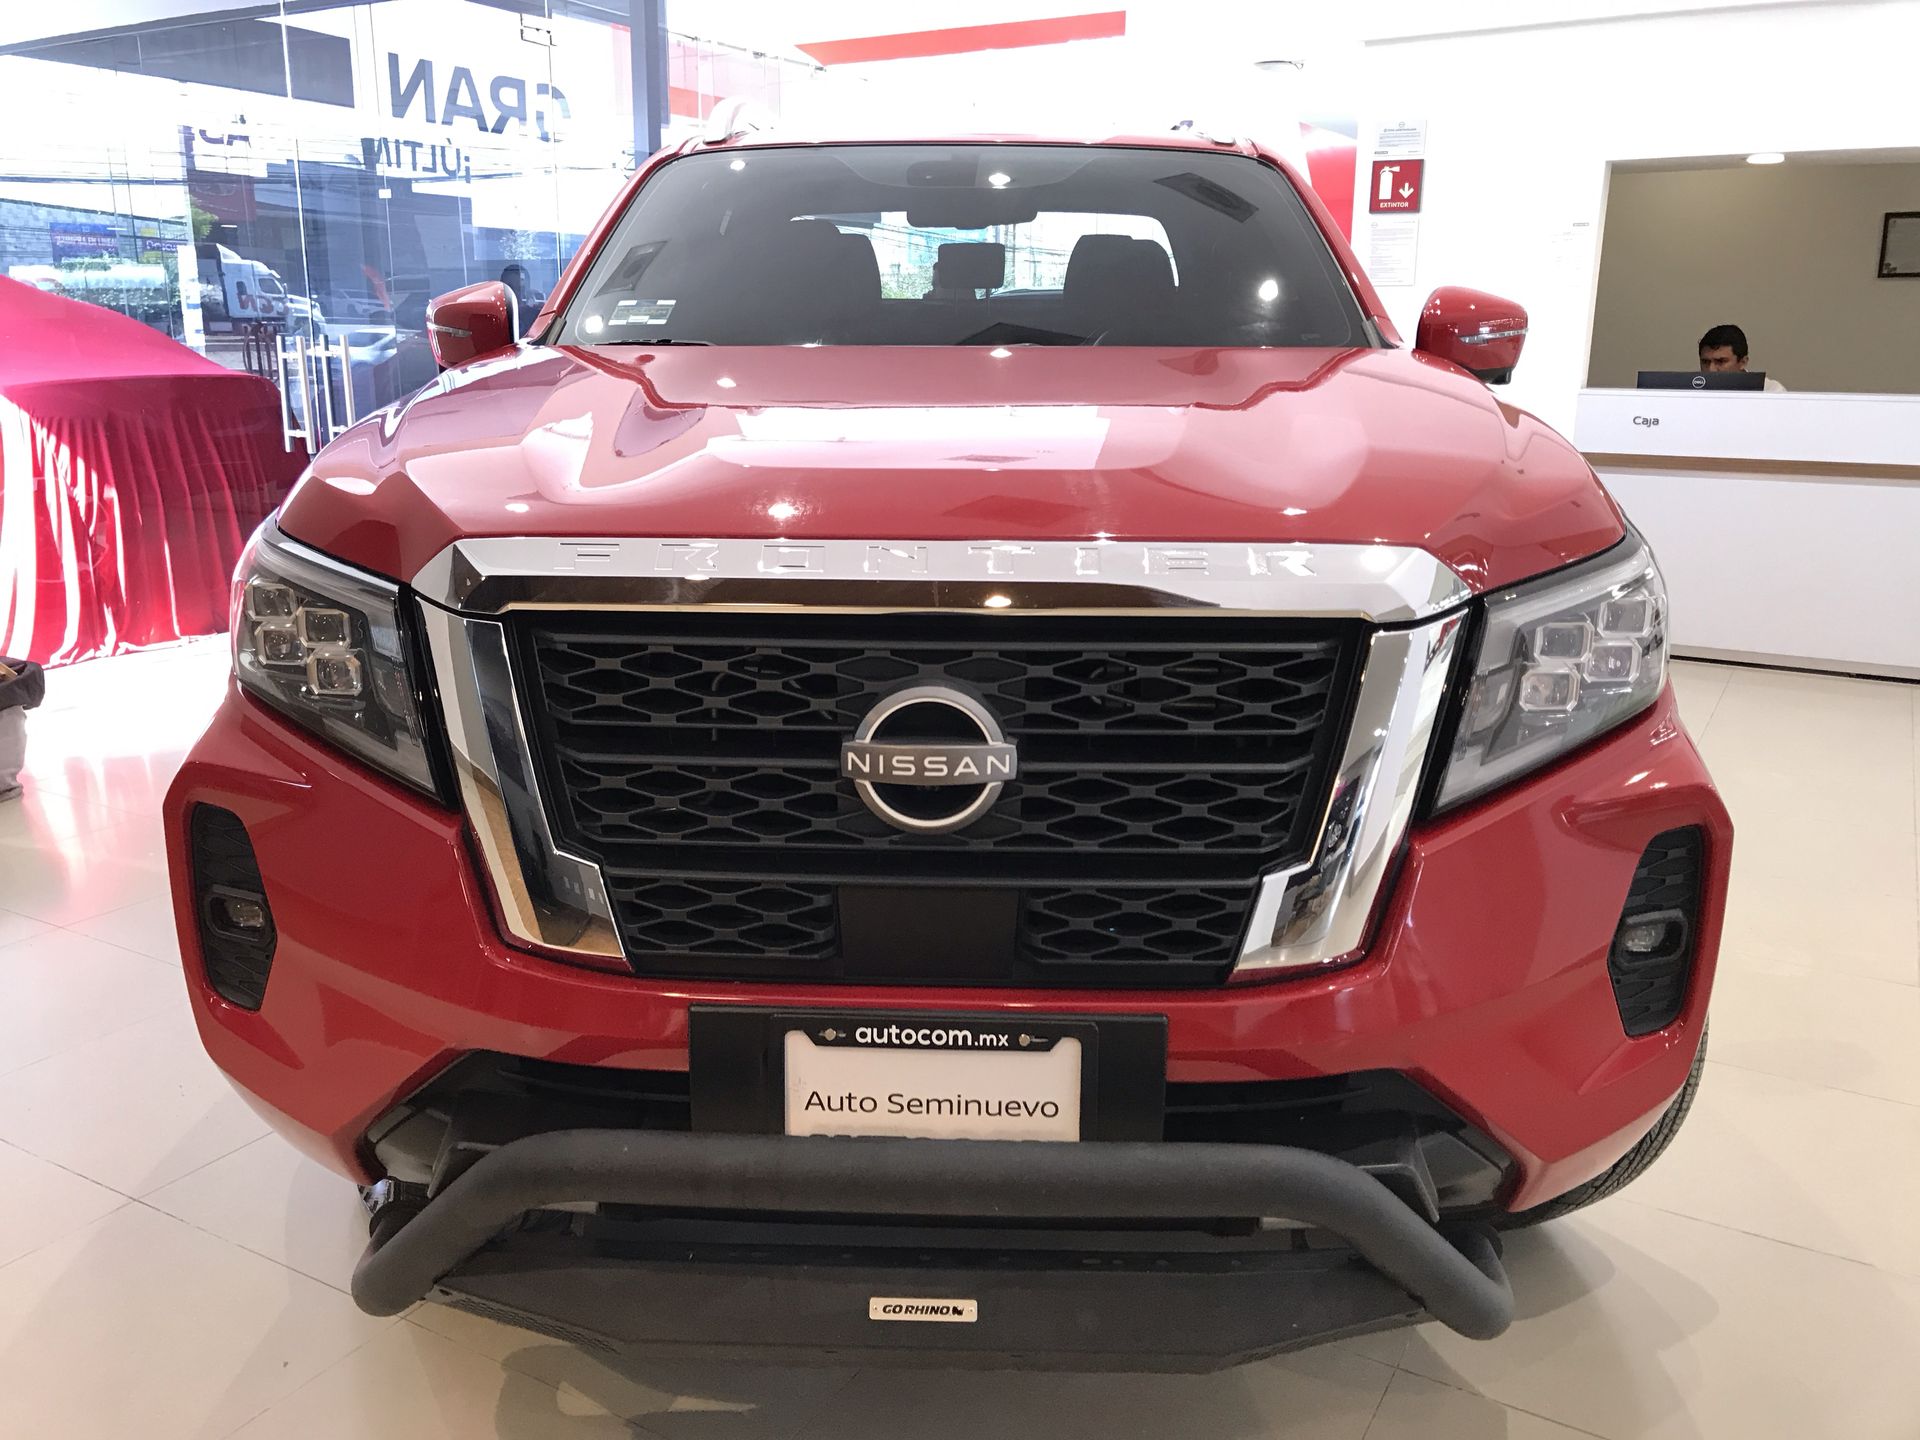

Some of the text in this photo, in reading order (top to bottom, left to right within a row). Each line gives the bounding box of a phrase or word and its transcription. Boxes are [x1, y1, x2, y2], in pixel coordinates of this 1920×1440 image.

[1380, 201, 1409, 209] EXTINTOR
[1632, 415, 1660, 428] Caja
[553, 541, 1318, 577] FRONTIER
[847, 751, 1010, 777] NISSAN
[855, 1024, 1009, 1047] autocom.mx
[804, 1090, 1060, 1118] Auto Seminuevo
